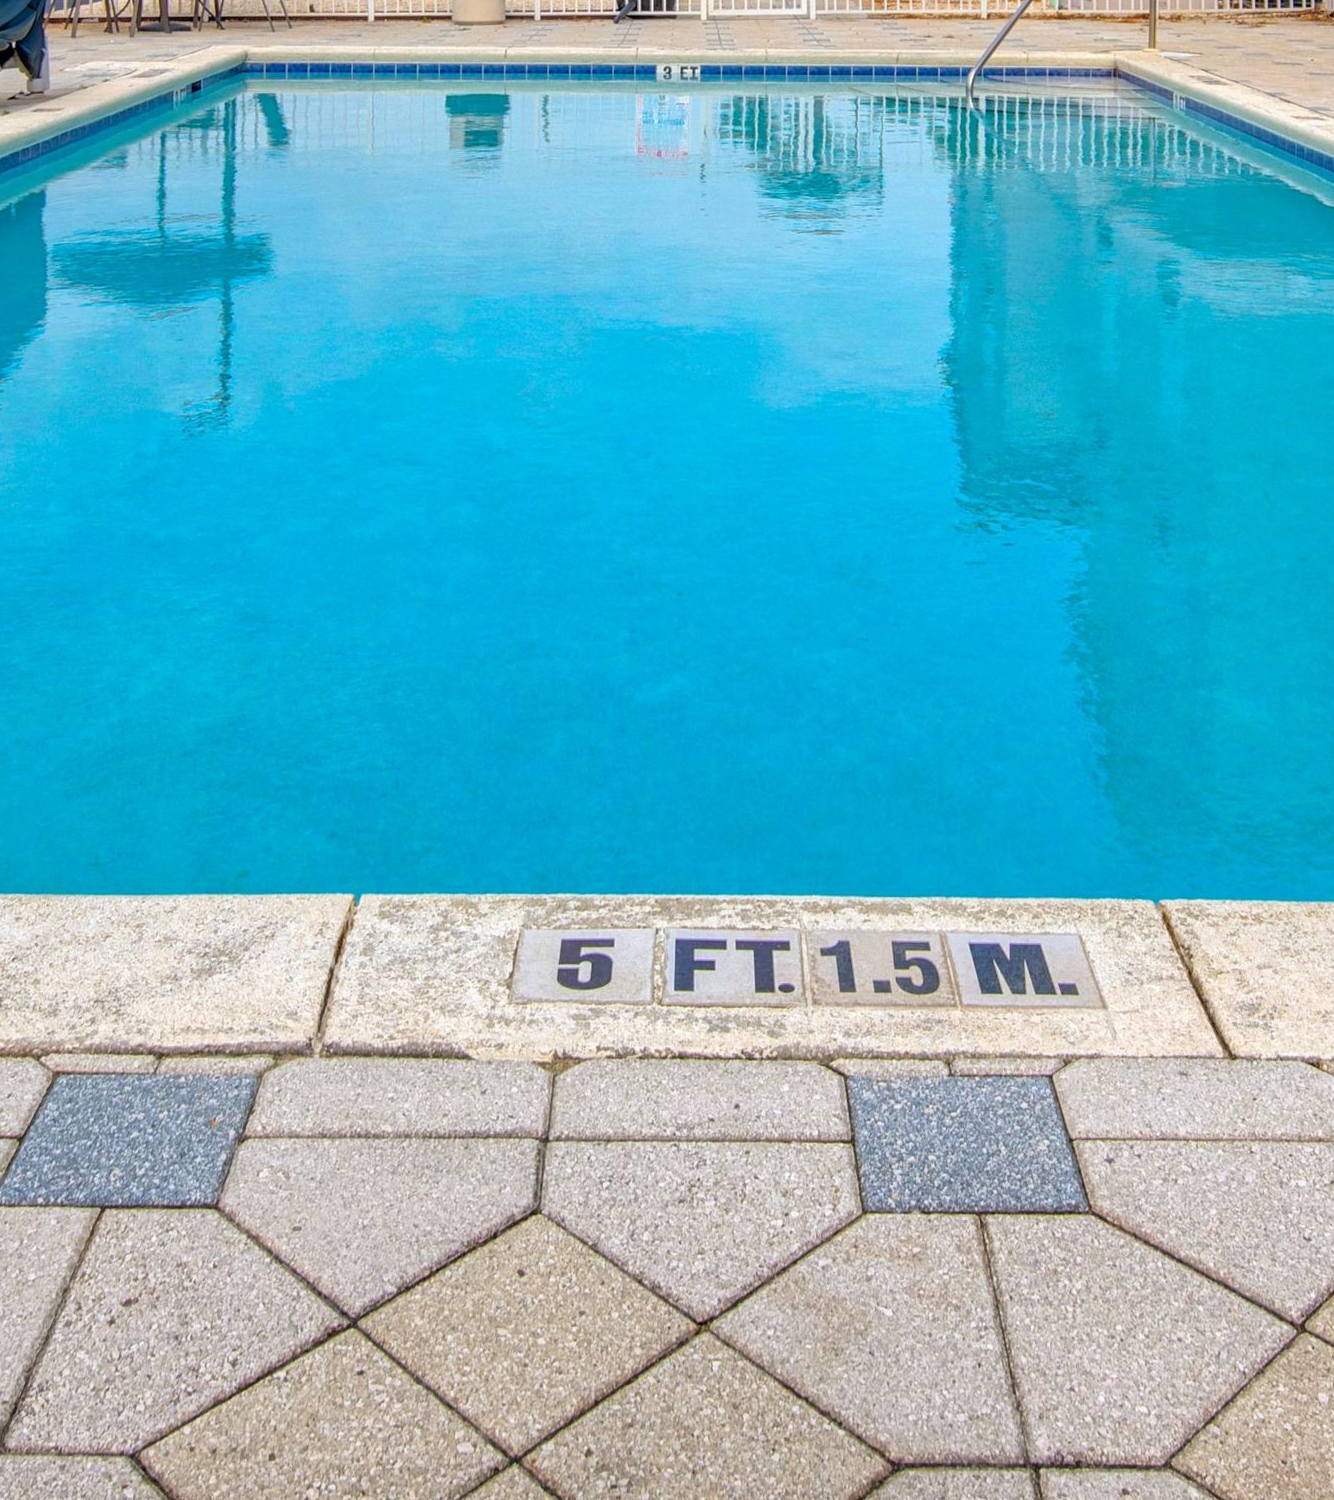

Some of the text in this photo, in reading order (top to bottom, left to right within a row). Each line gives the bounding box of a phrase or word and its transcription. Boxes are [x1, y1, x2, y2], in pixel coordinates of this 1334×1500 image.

[556, 937, 1080, 996] 5 FT. 1.5 M.
